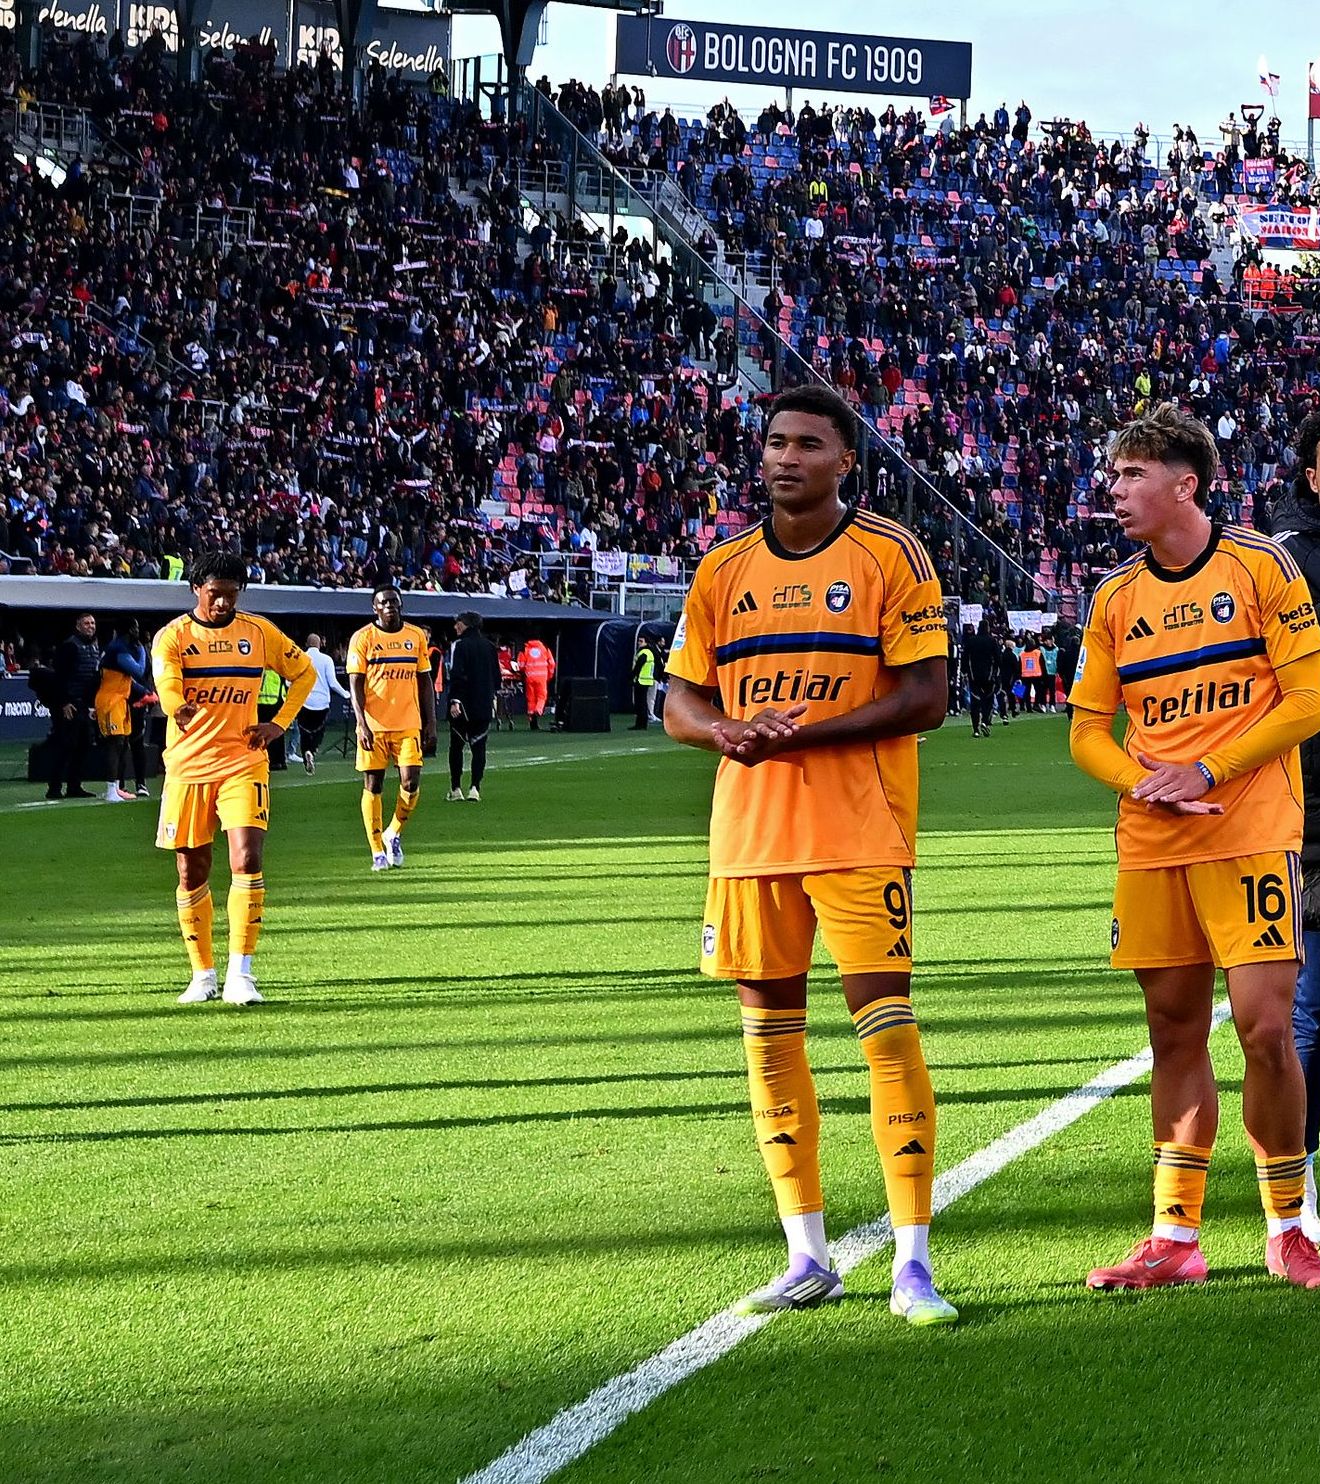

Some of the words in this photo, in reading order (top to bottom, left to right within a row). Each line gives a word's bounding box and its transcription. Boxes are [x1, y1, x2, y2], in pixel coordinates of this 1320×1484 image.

[39, 0, 107, 34] elenella
[704, 32, 816, 77] BOLOGNA
[827, 42, 857, 80] FC
[864, 45, 922, 84] 1909
[901, 604, 943, 624] bet36
[1278, 602, 1313, 624] bet3
[1289, 618, 1316, 634] Scor
[185, 686, 252, 705] Cetilar
[739, 670, 852, 707] Cetilar
[1142, 673, 1256, 727] Cetilar
[883, 880, 908, 930] 9
[1240, 873, 1287, 924] 16
[755, 1104, 793, 1120] PISA
[888, 1111, 926, 1126] PISA
